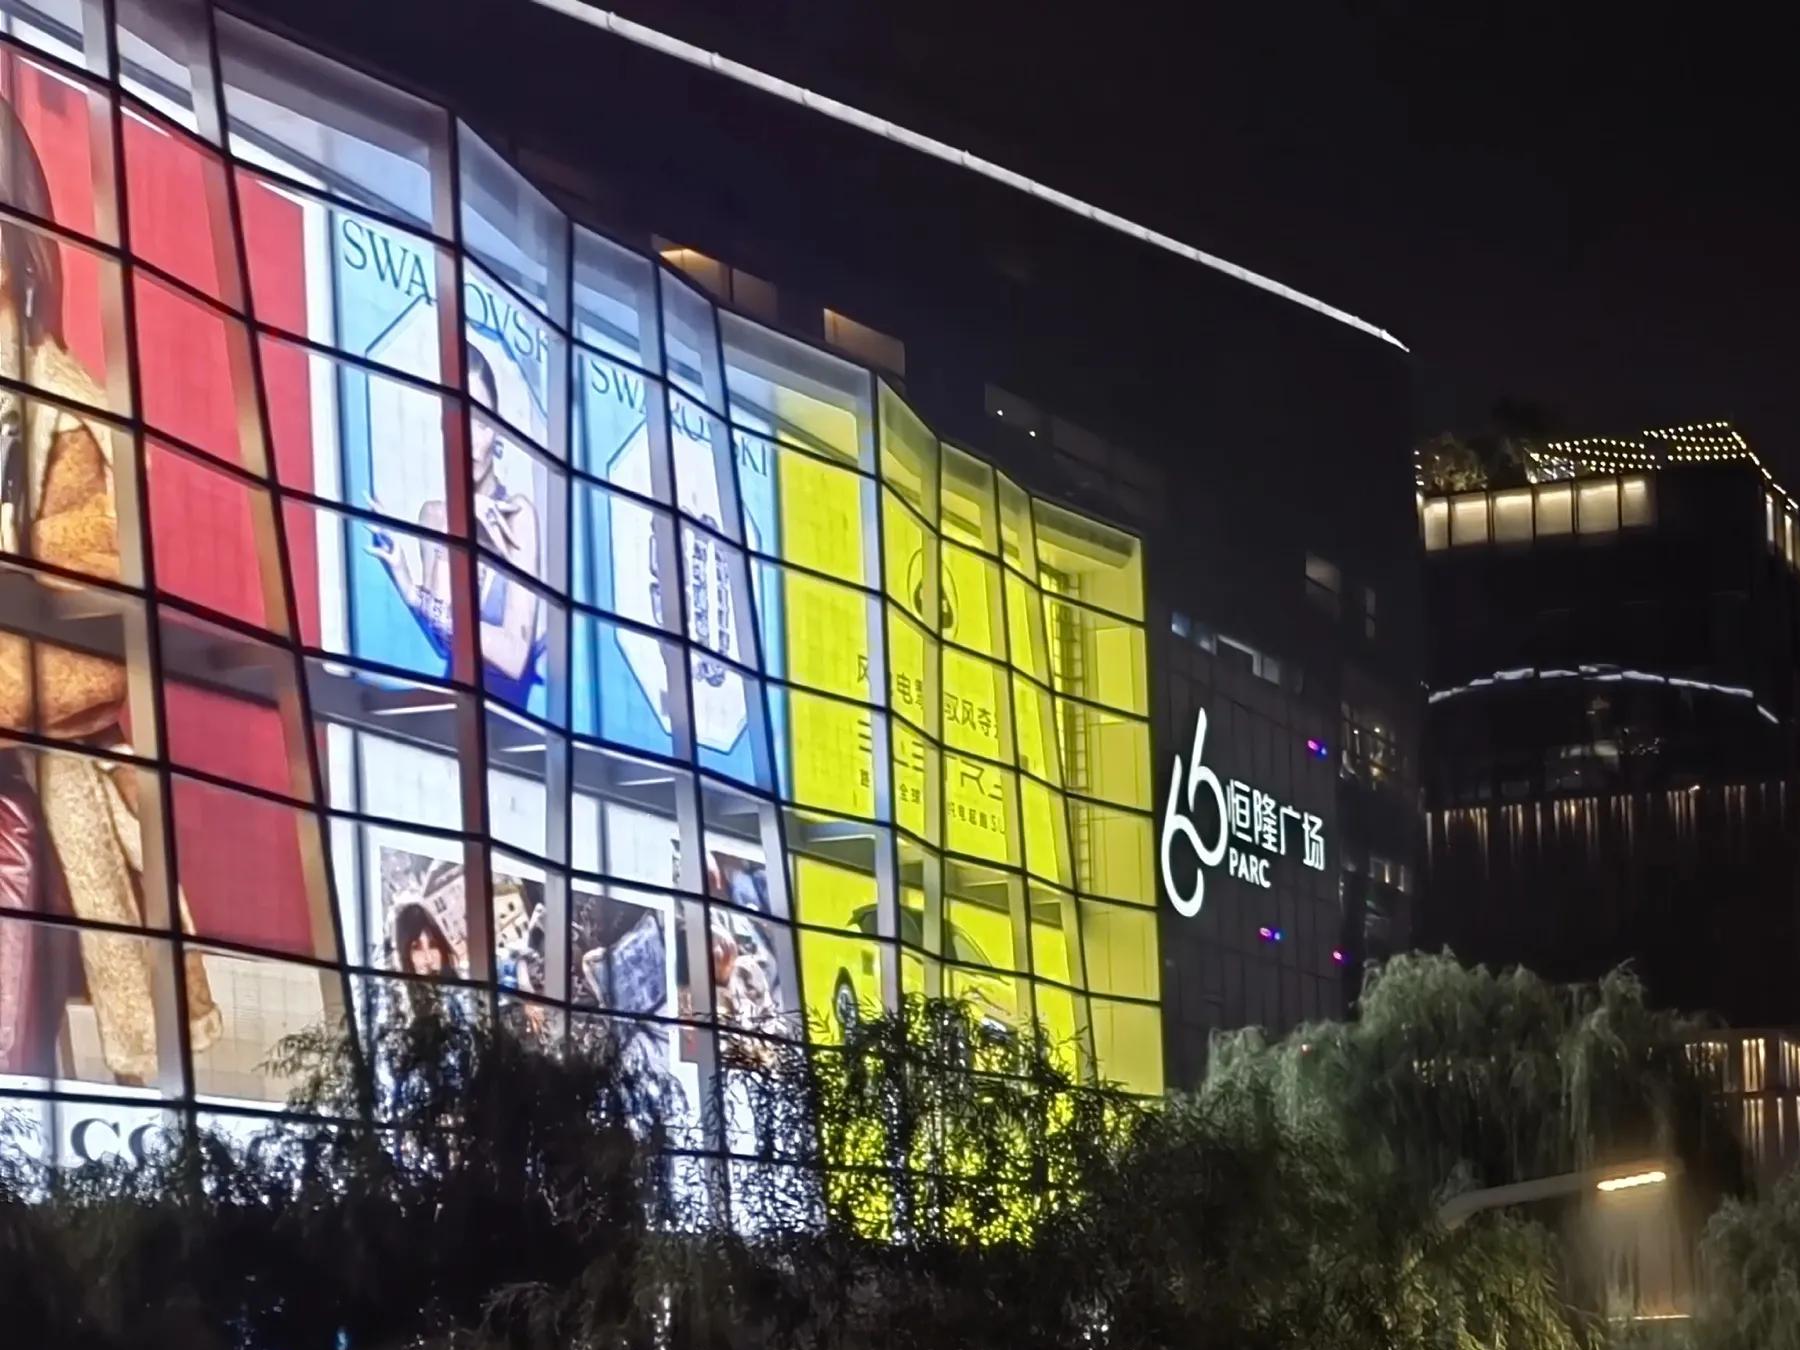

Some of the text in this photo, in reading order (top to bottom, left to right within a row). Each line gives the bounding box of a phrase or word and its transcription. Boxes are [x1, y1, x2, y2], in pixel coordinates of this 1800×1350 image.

[1226, 778, 1325, 871] 恒隆广场
[1229, 847, 1271, 888] PARC
